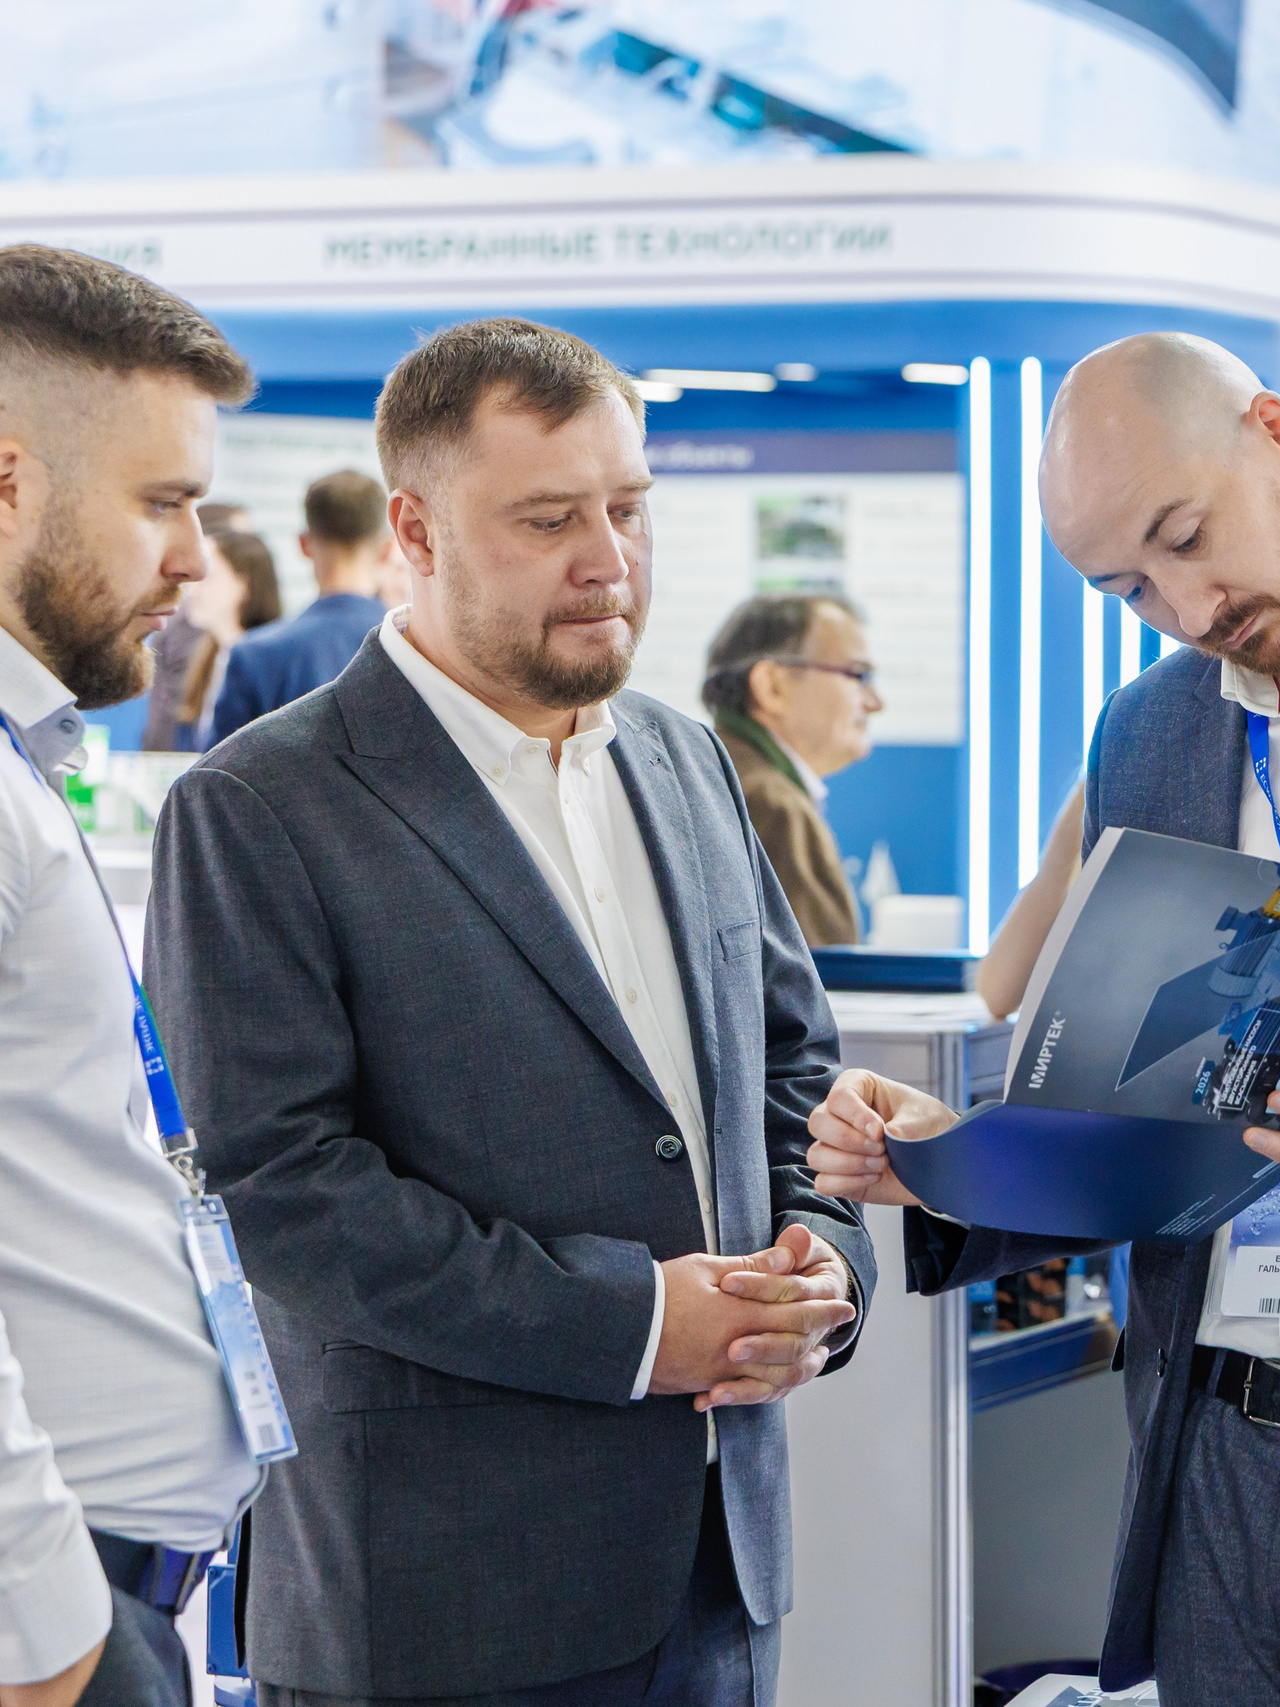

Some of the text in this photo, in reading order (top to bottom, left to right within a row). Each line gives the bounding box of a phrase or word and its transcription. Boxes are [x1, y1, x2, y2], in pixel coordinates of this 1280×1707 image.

[613, 221, 893, 261] ТЕХНОЛОГИИ
[1244, 1020, 1262, 1048] НАСОСЫ
[1195, 1070, 1211, 1095] 2026
